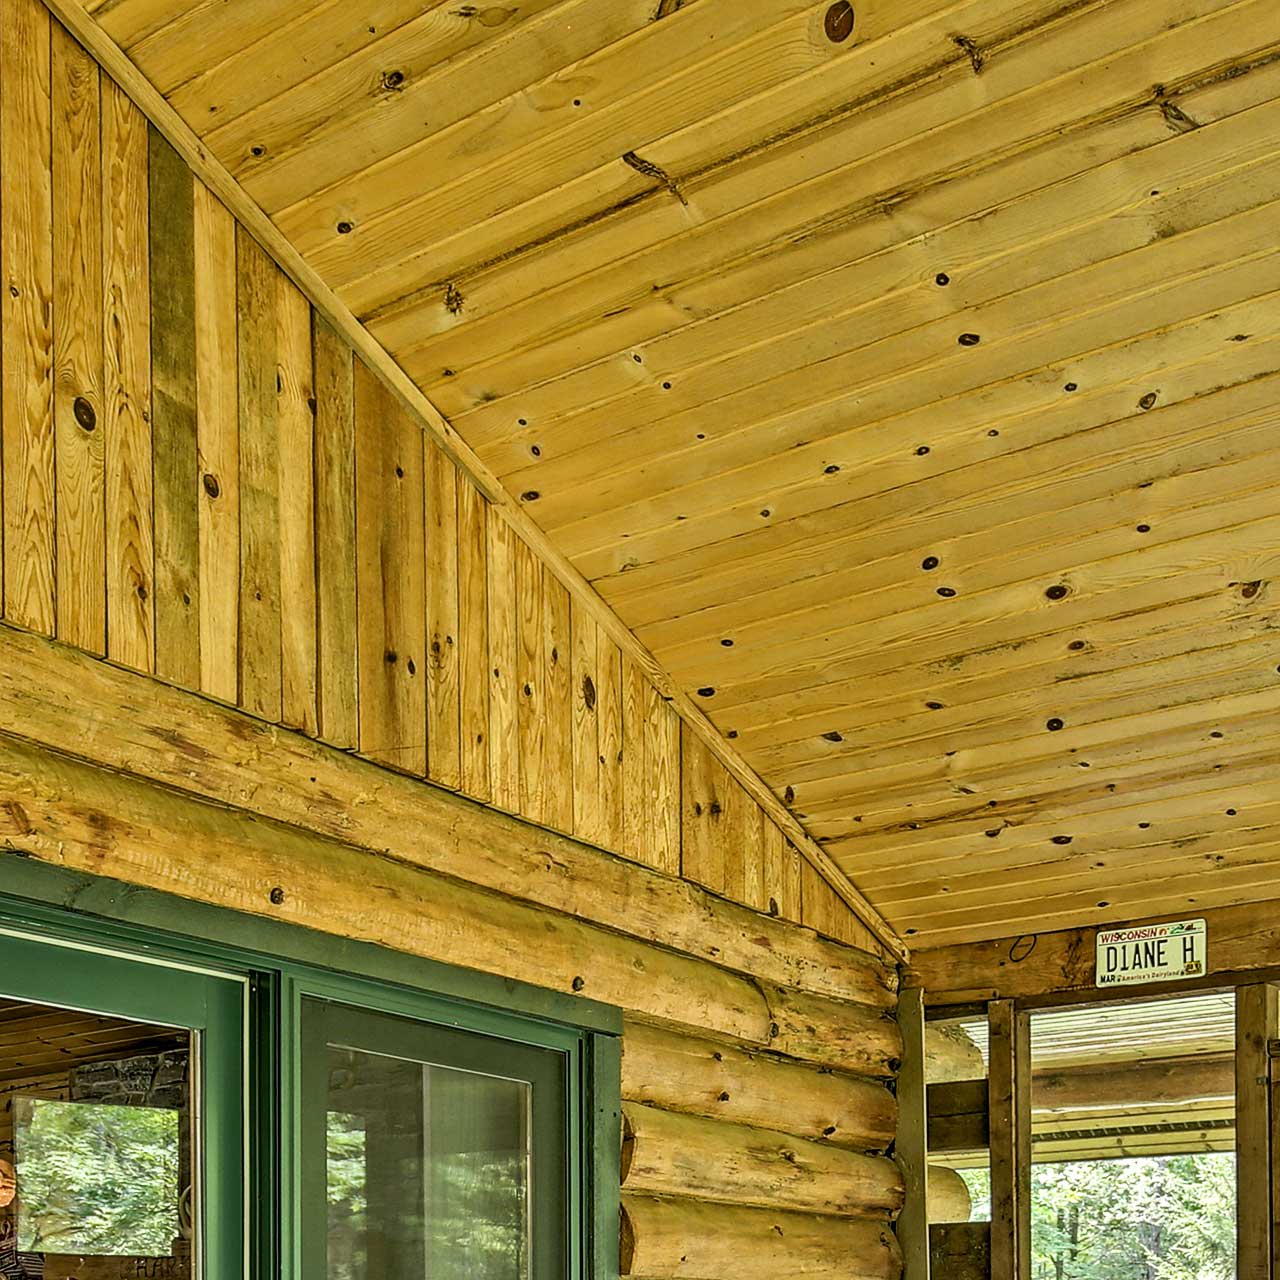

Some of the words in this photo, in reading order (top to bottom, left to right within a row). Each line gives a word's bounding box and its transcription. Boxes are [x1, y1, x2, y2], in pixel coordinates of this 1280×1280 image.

[1101, 927, 1158, 943] WISCONSIN
[1182, 935, 1195, 963] H
[1100, 974, 1116, 983] MAR
